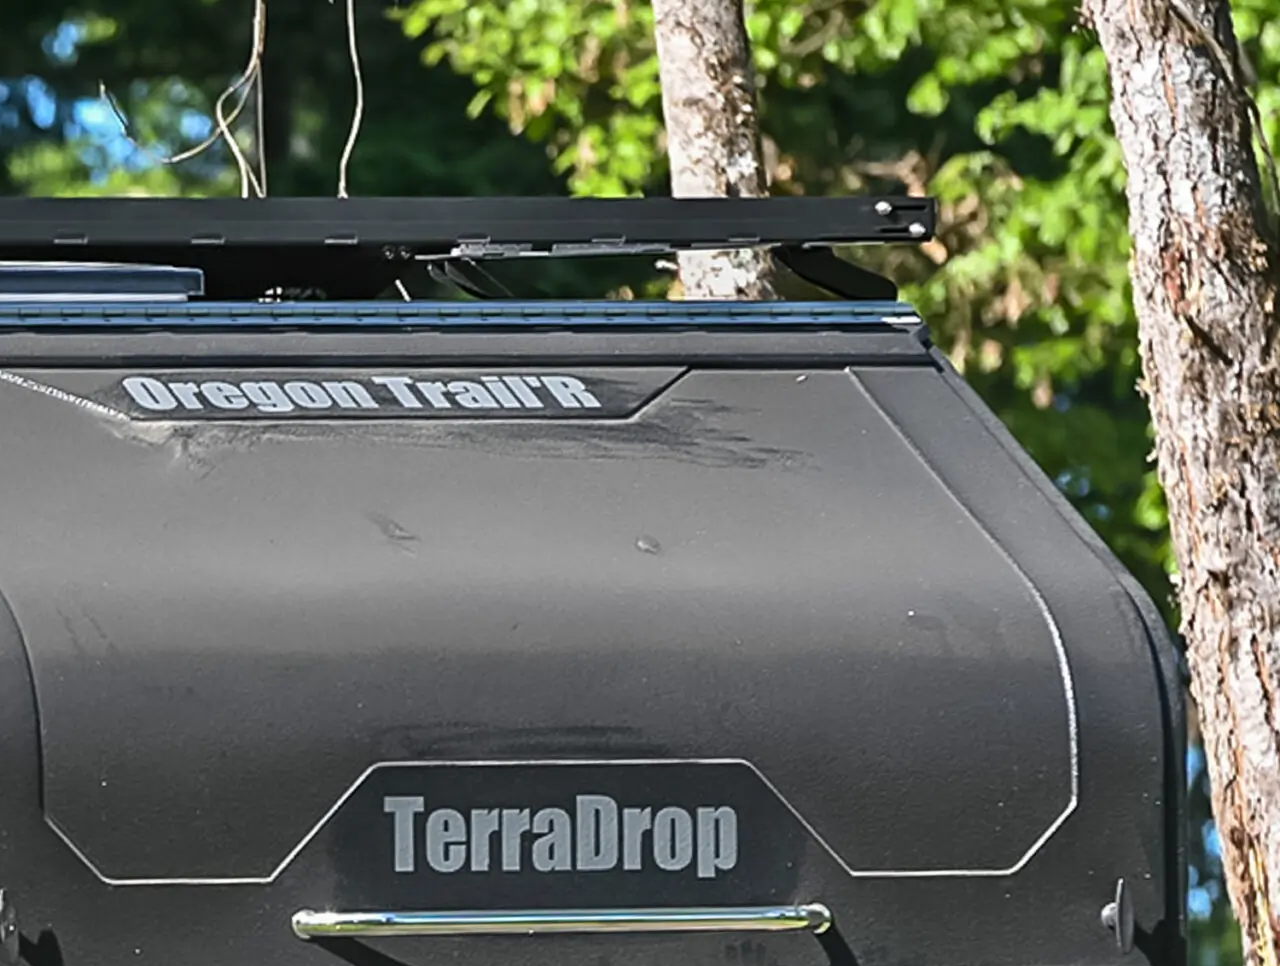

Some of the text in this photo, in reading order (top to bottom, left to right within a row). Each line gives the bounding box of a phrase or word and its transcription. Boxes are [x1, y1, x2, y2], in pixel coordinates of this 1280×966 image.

[122, 375, 602, 412] Oregon Trail'R
[384, 795, 738, 878] TerraDrop
